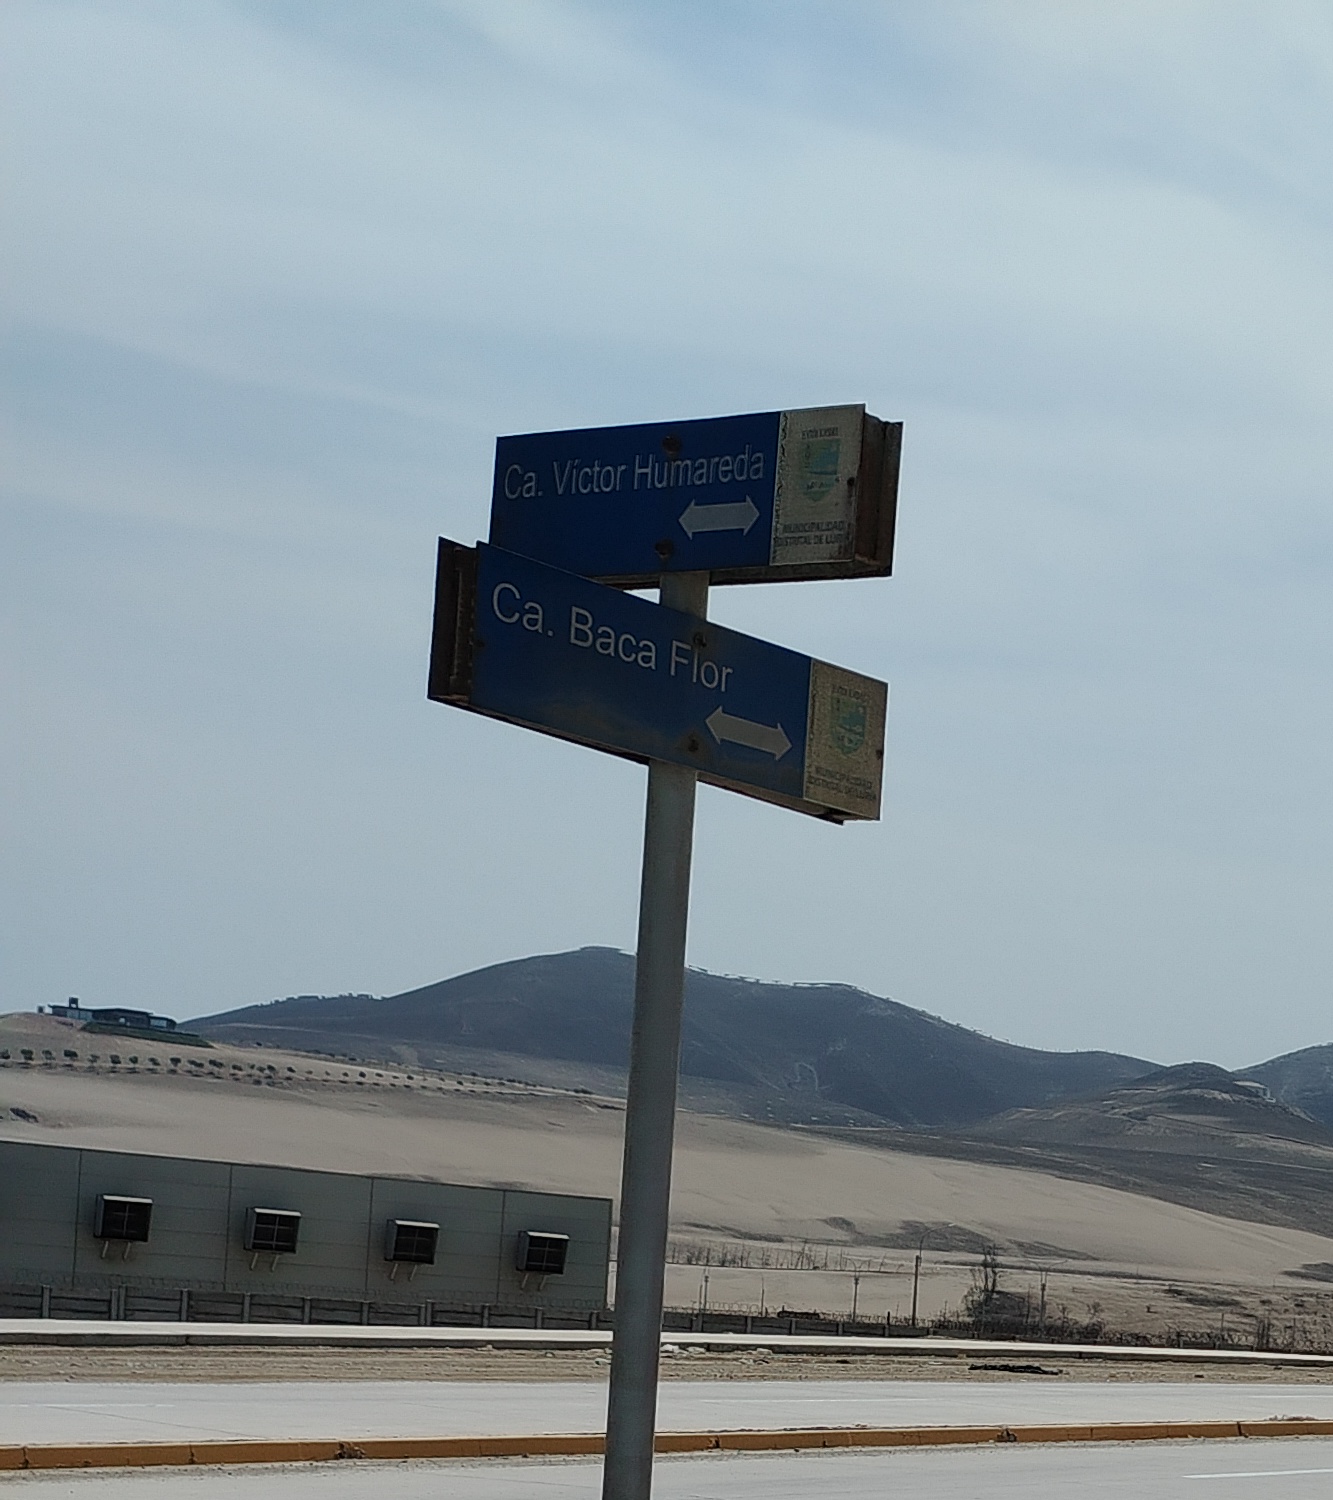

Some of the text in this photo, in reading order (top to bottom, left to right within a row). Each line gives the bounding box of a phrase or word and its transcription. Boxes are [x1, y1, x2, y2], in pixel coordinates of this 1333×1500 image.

[504, 464, 543, 500] Ca.
[633, 444, 765, 490] Humareda
[492, 582, 734, 692] Ca. Baca Flor
